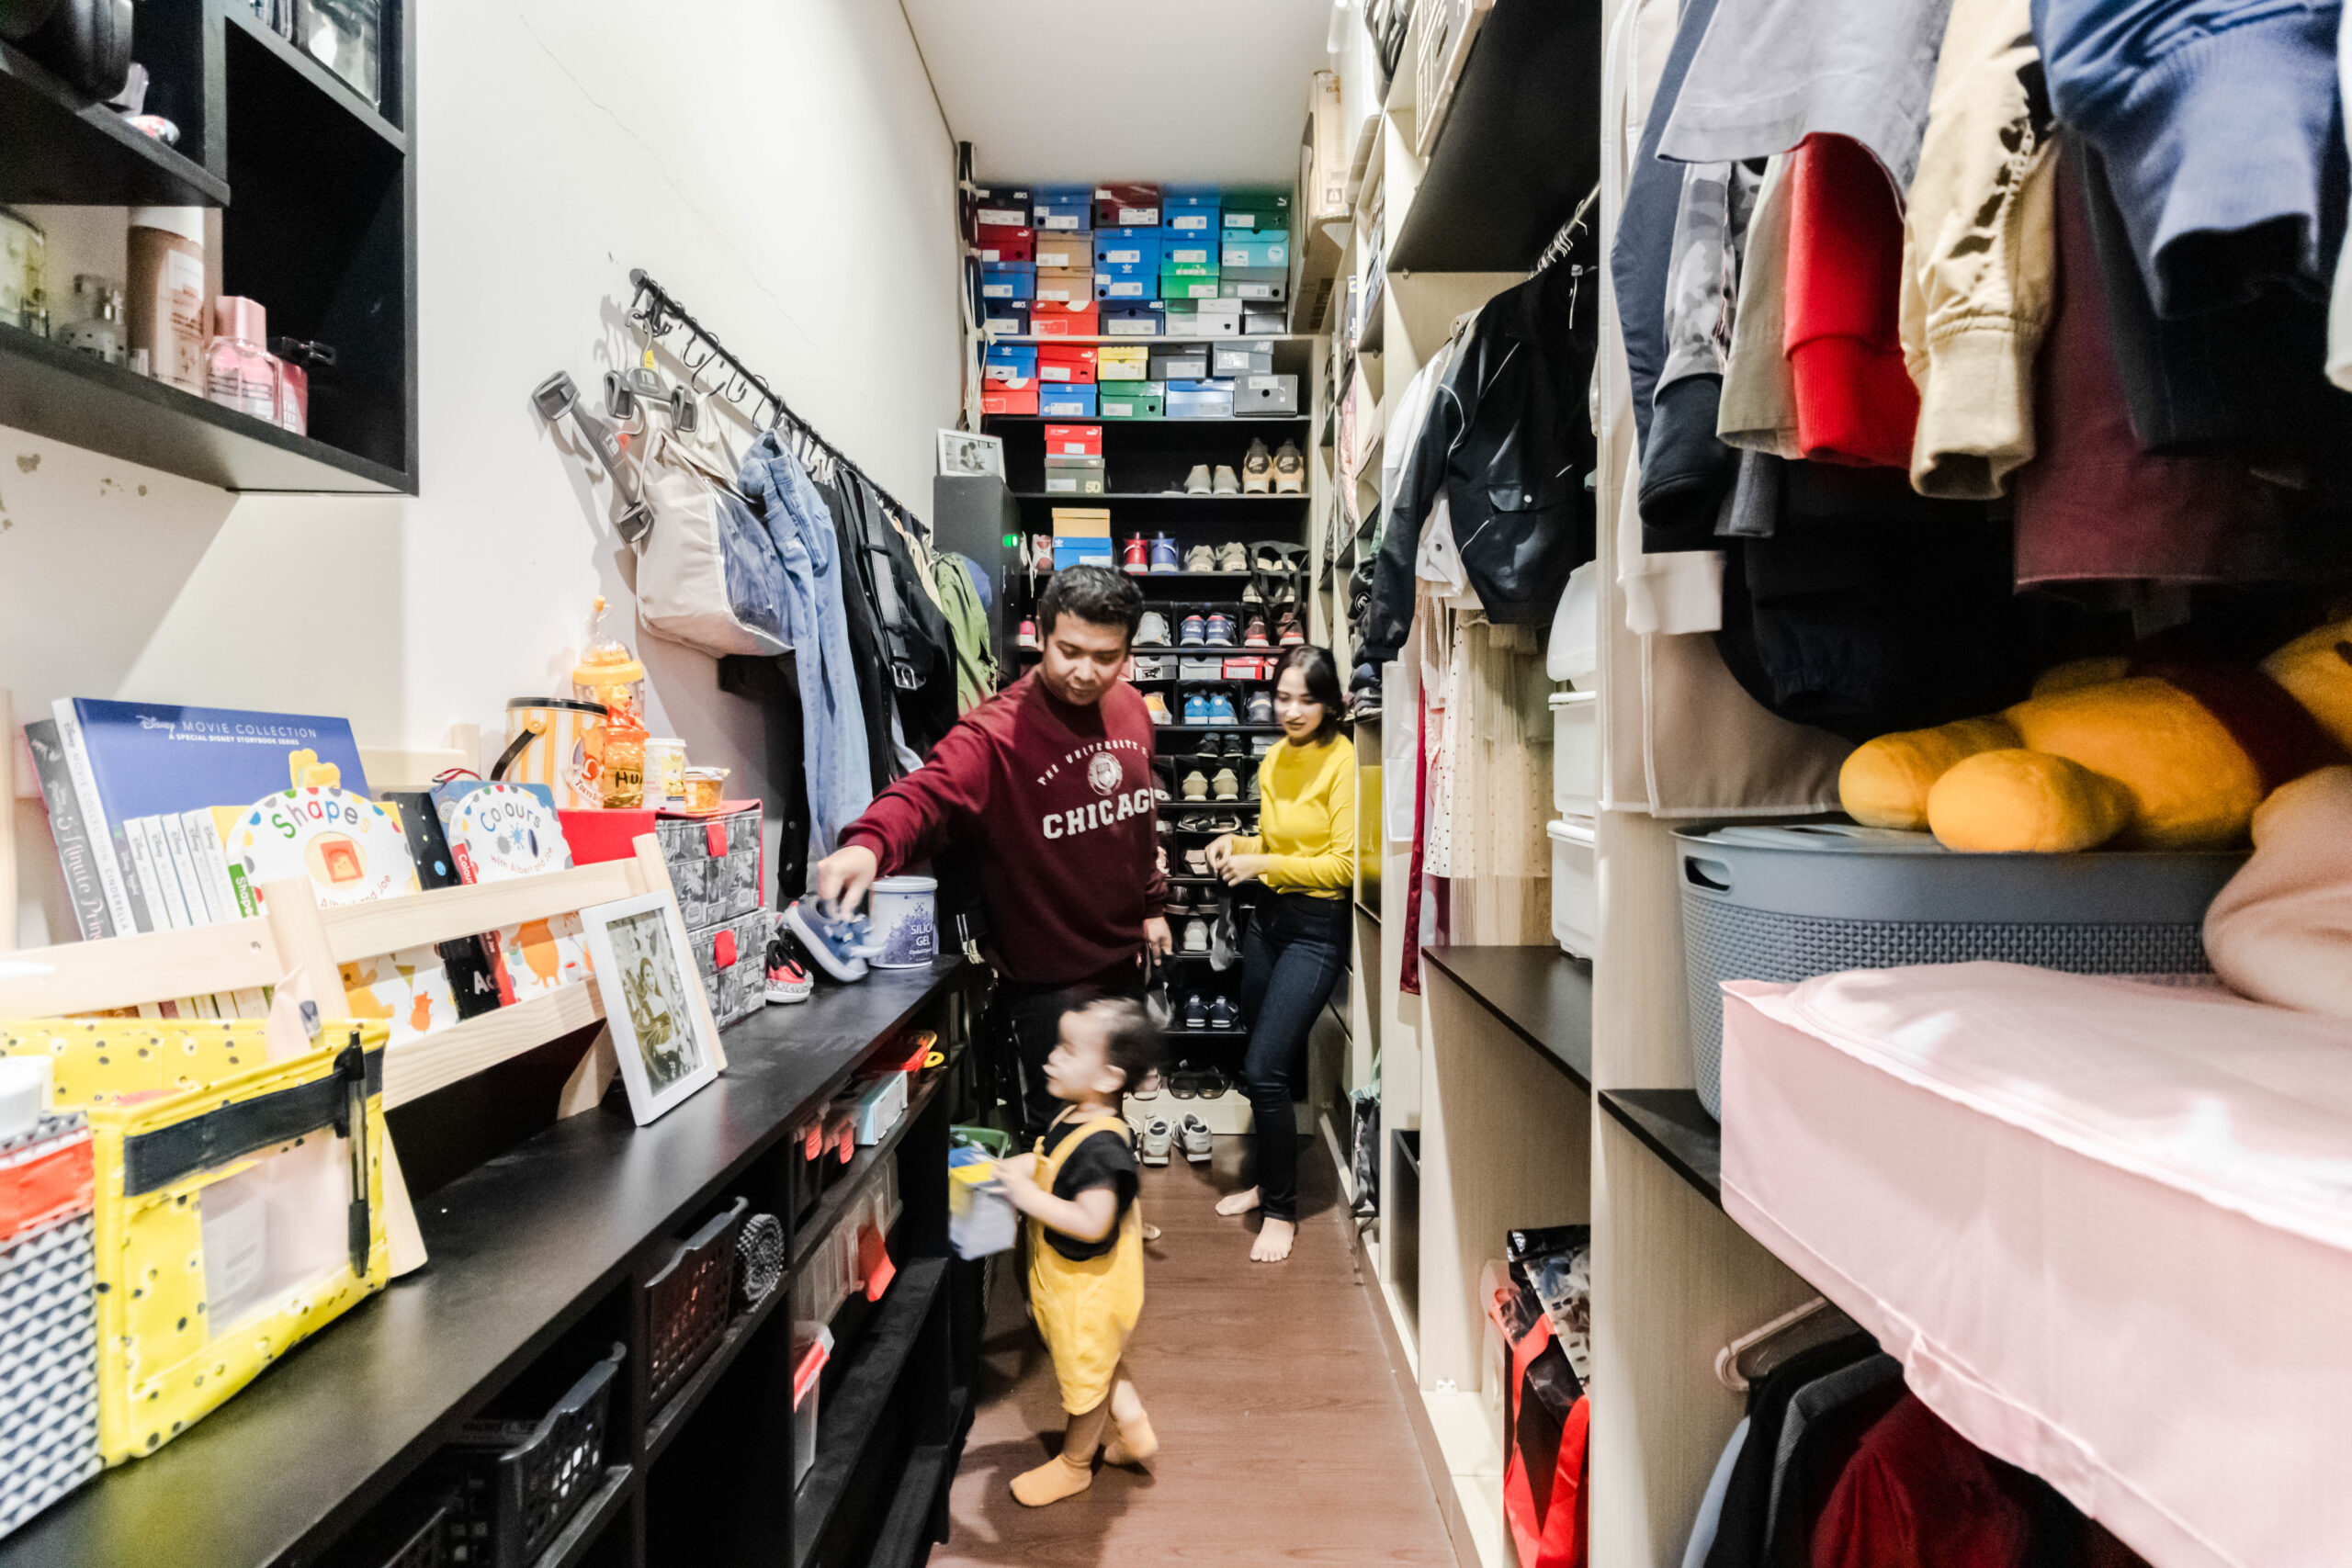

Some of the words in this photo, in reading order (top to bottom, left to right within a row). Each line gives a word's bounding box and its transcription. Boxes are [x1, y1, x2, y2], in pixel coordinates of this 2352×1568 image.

[136, 715, 175, 733] Disney
[182, 721, 230, 734] MOVIE
[235, 724, 317, 739] COLLECTION
[176, 734, 208, 742] SPECIAL
[236, 736, 277, 745] STORYBOOK
[1065, 739, 1138, 764] UNIVERSITY
[271, 800, 371, 839] Shapes
[481, 801, 540, 832] Colours
[1043, 786, 1155, 840] CHICAG
[84, 792, 108, 861] COLLECTION
[104, 868, 130, 931] CINDERELLA
[458, 853, 474, 885] Colour
[235, 875, 254, 917] Shape
[910, 922, 933, 935] SILIC
[916, 935, 931, 947] GEL
